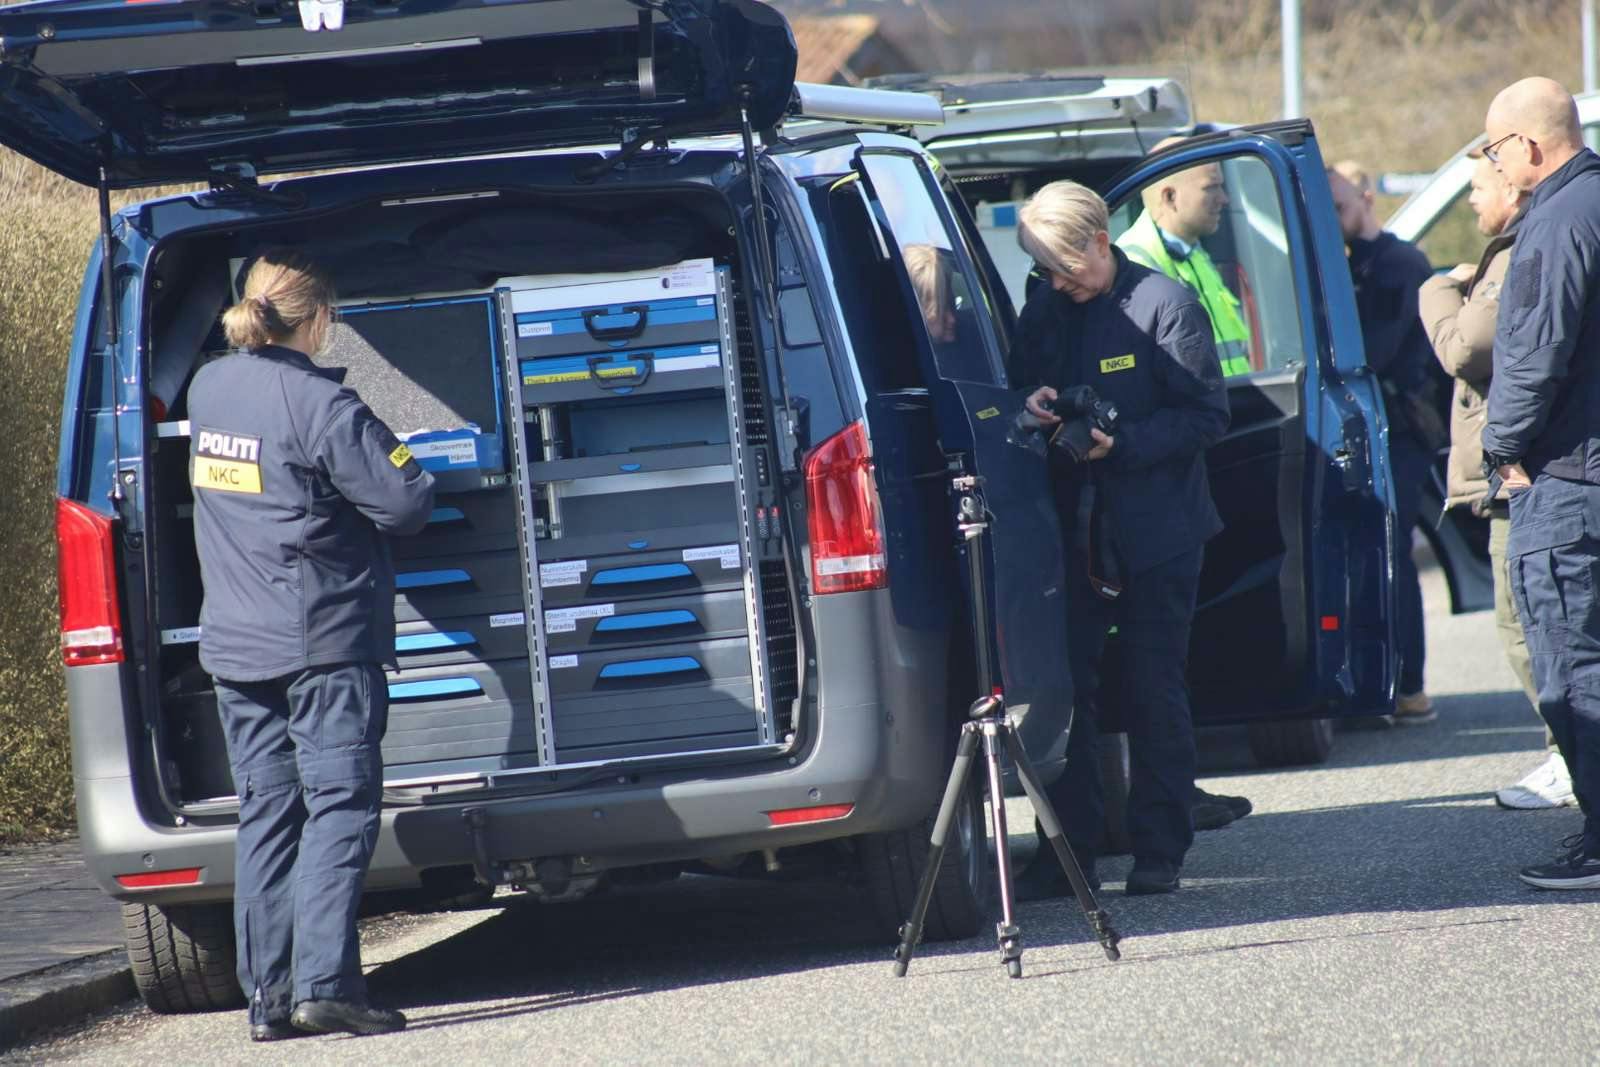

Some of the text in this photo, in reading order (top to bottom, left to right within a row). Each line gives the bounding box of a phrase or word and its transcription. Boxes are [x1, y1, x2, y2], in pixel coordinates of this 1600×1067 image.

[1106, 357, 1129, 370] NKC
[198, 431, 258, 460] POLITI
[208, 465, 240, 485] NKC
